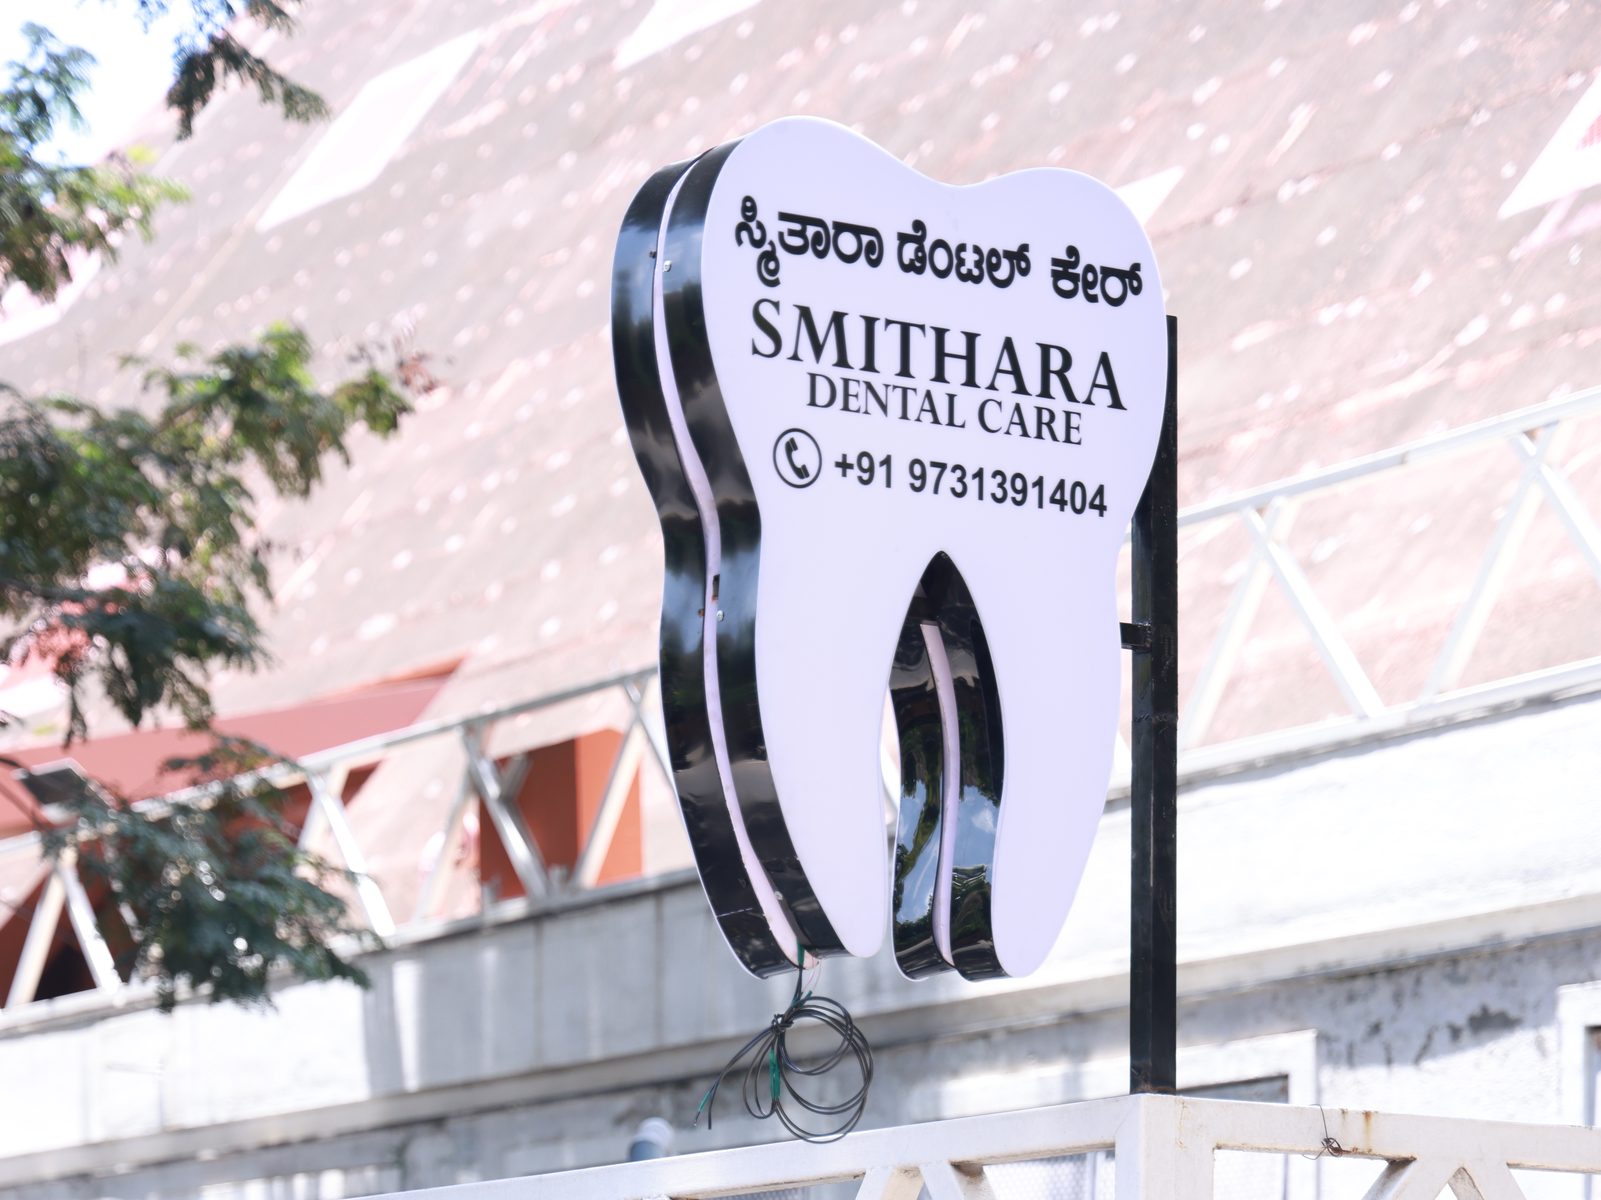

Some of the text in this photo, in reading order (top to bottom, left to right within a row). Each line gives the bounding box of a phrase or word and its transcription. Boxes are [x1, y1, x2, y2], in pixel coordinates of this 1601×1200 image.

[735, 196, 1142, 307] ಸ್ಮಿತಾರಾ ಡೆಂಟಲ್ ಕೇರ್
[752, 299, 1127, 410] SMITHARA
[807, 373, 1081, 445] DENTAL CARE
[835, 451, 1107, 517] +91 9731391404
